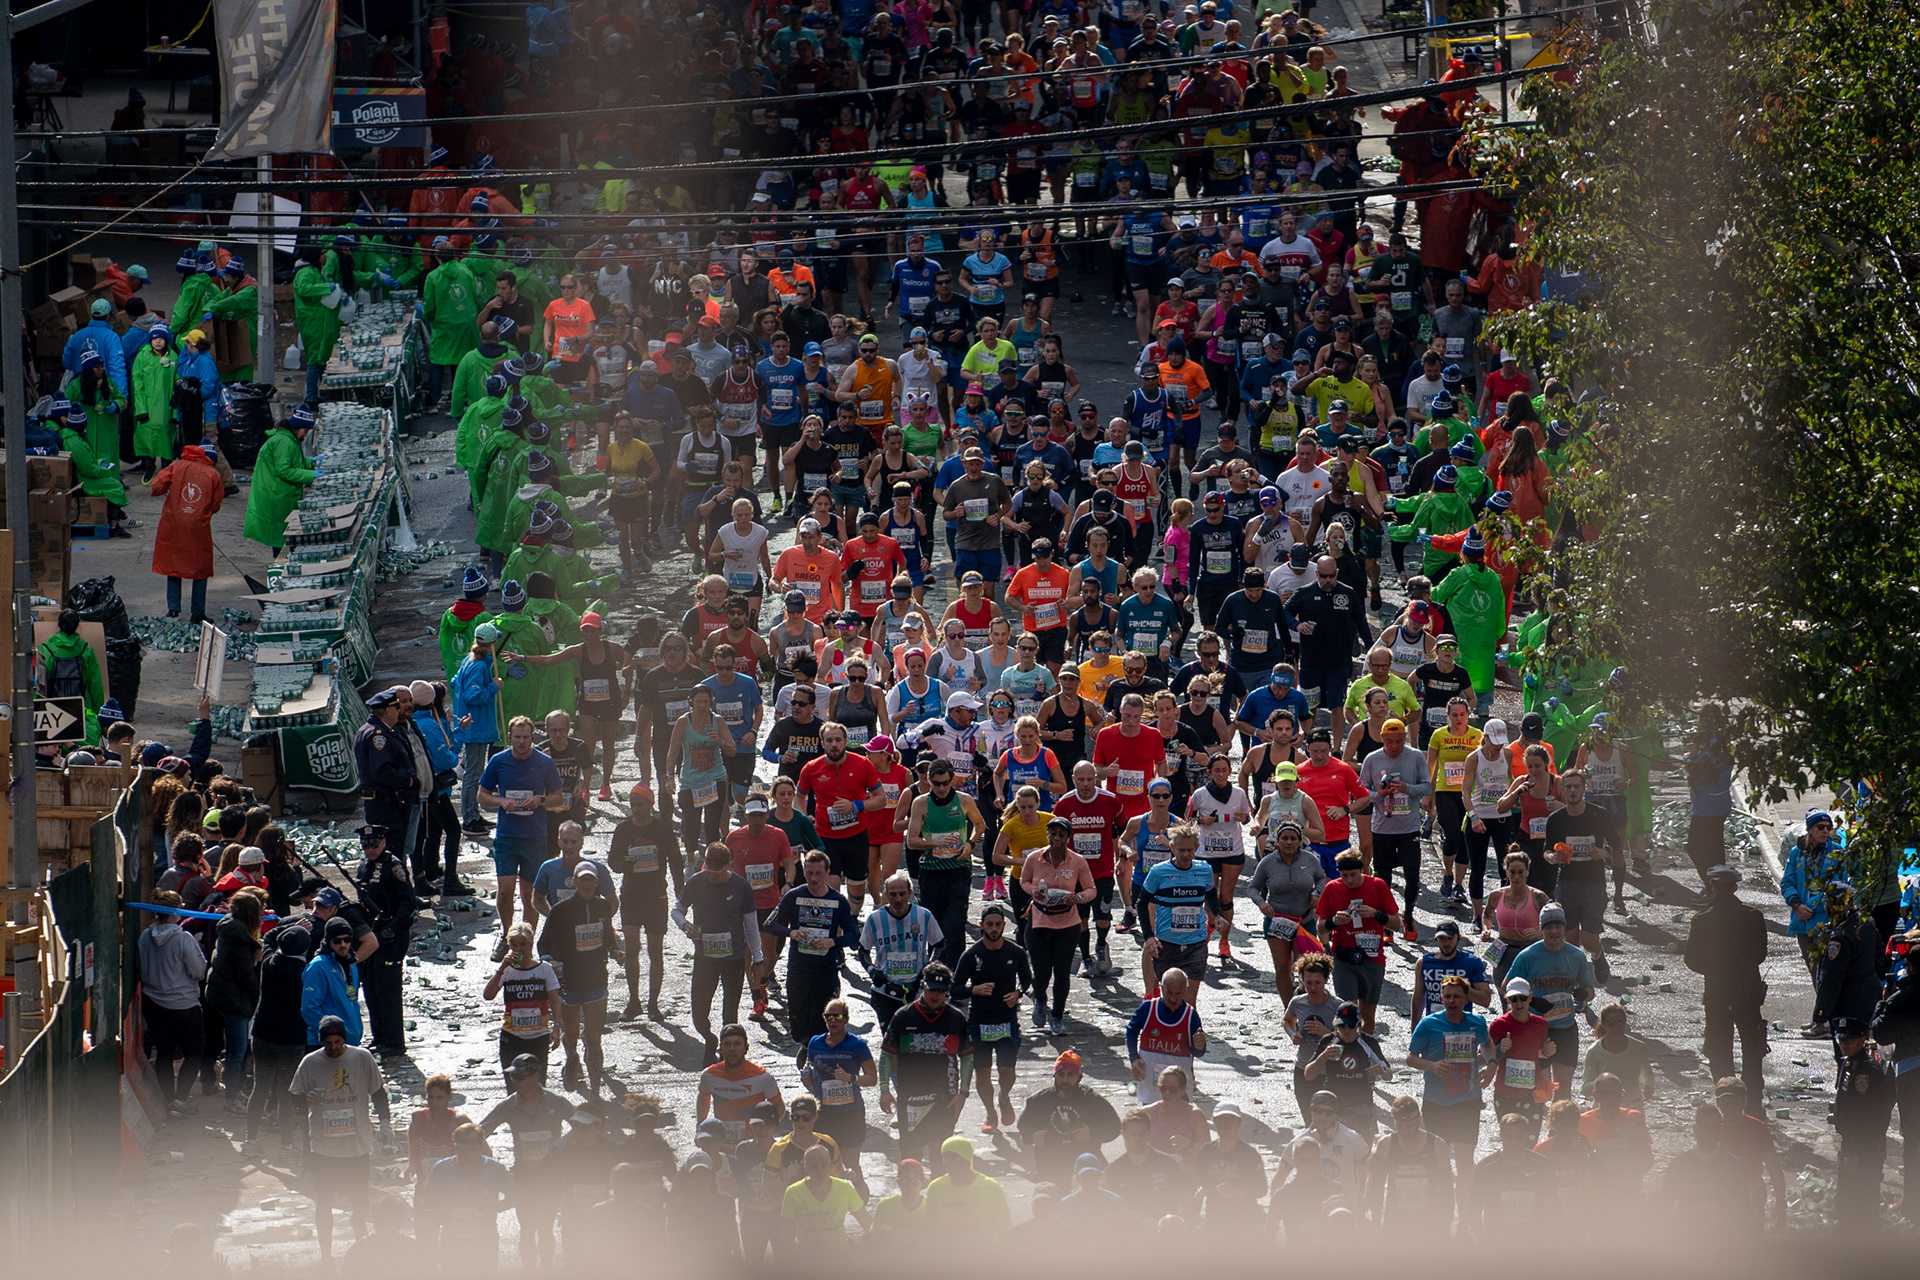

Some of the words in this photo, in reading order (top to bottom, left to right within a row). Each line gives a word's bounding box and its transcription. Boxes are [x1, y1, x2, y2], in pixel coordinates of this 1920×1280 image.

[352, 102, 400, 122] Poland
[372, 128, 386, 136] 1845
[654, 279, 682, 294] NYC
[1322, 381, 1339, 391] BOB
[835, 443, 859, 452] PERU
[1125, 484, 1147, 492] PPTC
[1262, 530, 1281, 544] DINO
[794, 572, 821, 581] BREGO
[1039, 609, 1056, 619] 47850
[789, 736, 819, 746] PERU
[1444, 737, 1473, 746] NATALIE
[330, 765, 345, 773] 1845
[1122, 778, 1139, 786] 43356
[1071, 816, 1105, 825] SIMONA
[1210, 838, 1228, 846] 19402
[750, 872, 770, 880] 43307
[1172, 888, 1198, 896] Marco
[1176, 915, 1195, 924] 38779
[878, 932, 924, 945] GUSTAVO
[892, 960, 911, 970] 52022
[524, 984, 545, 992] YORK
[517, 991, 534, 999] CITY
[516, 1016, 537, 1025] 43077
[1148, 1039, 1181, 1053] ITALIA
[1451, 1043, 1470, 1053] 33441
[1510, 1067, 1531, 1079] 53436
[1444, 1076, 1470, 1095] GO
[828, 1087, 848, 1097] 48632
[328, 1118, 349, 1127] 43372
